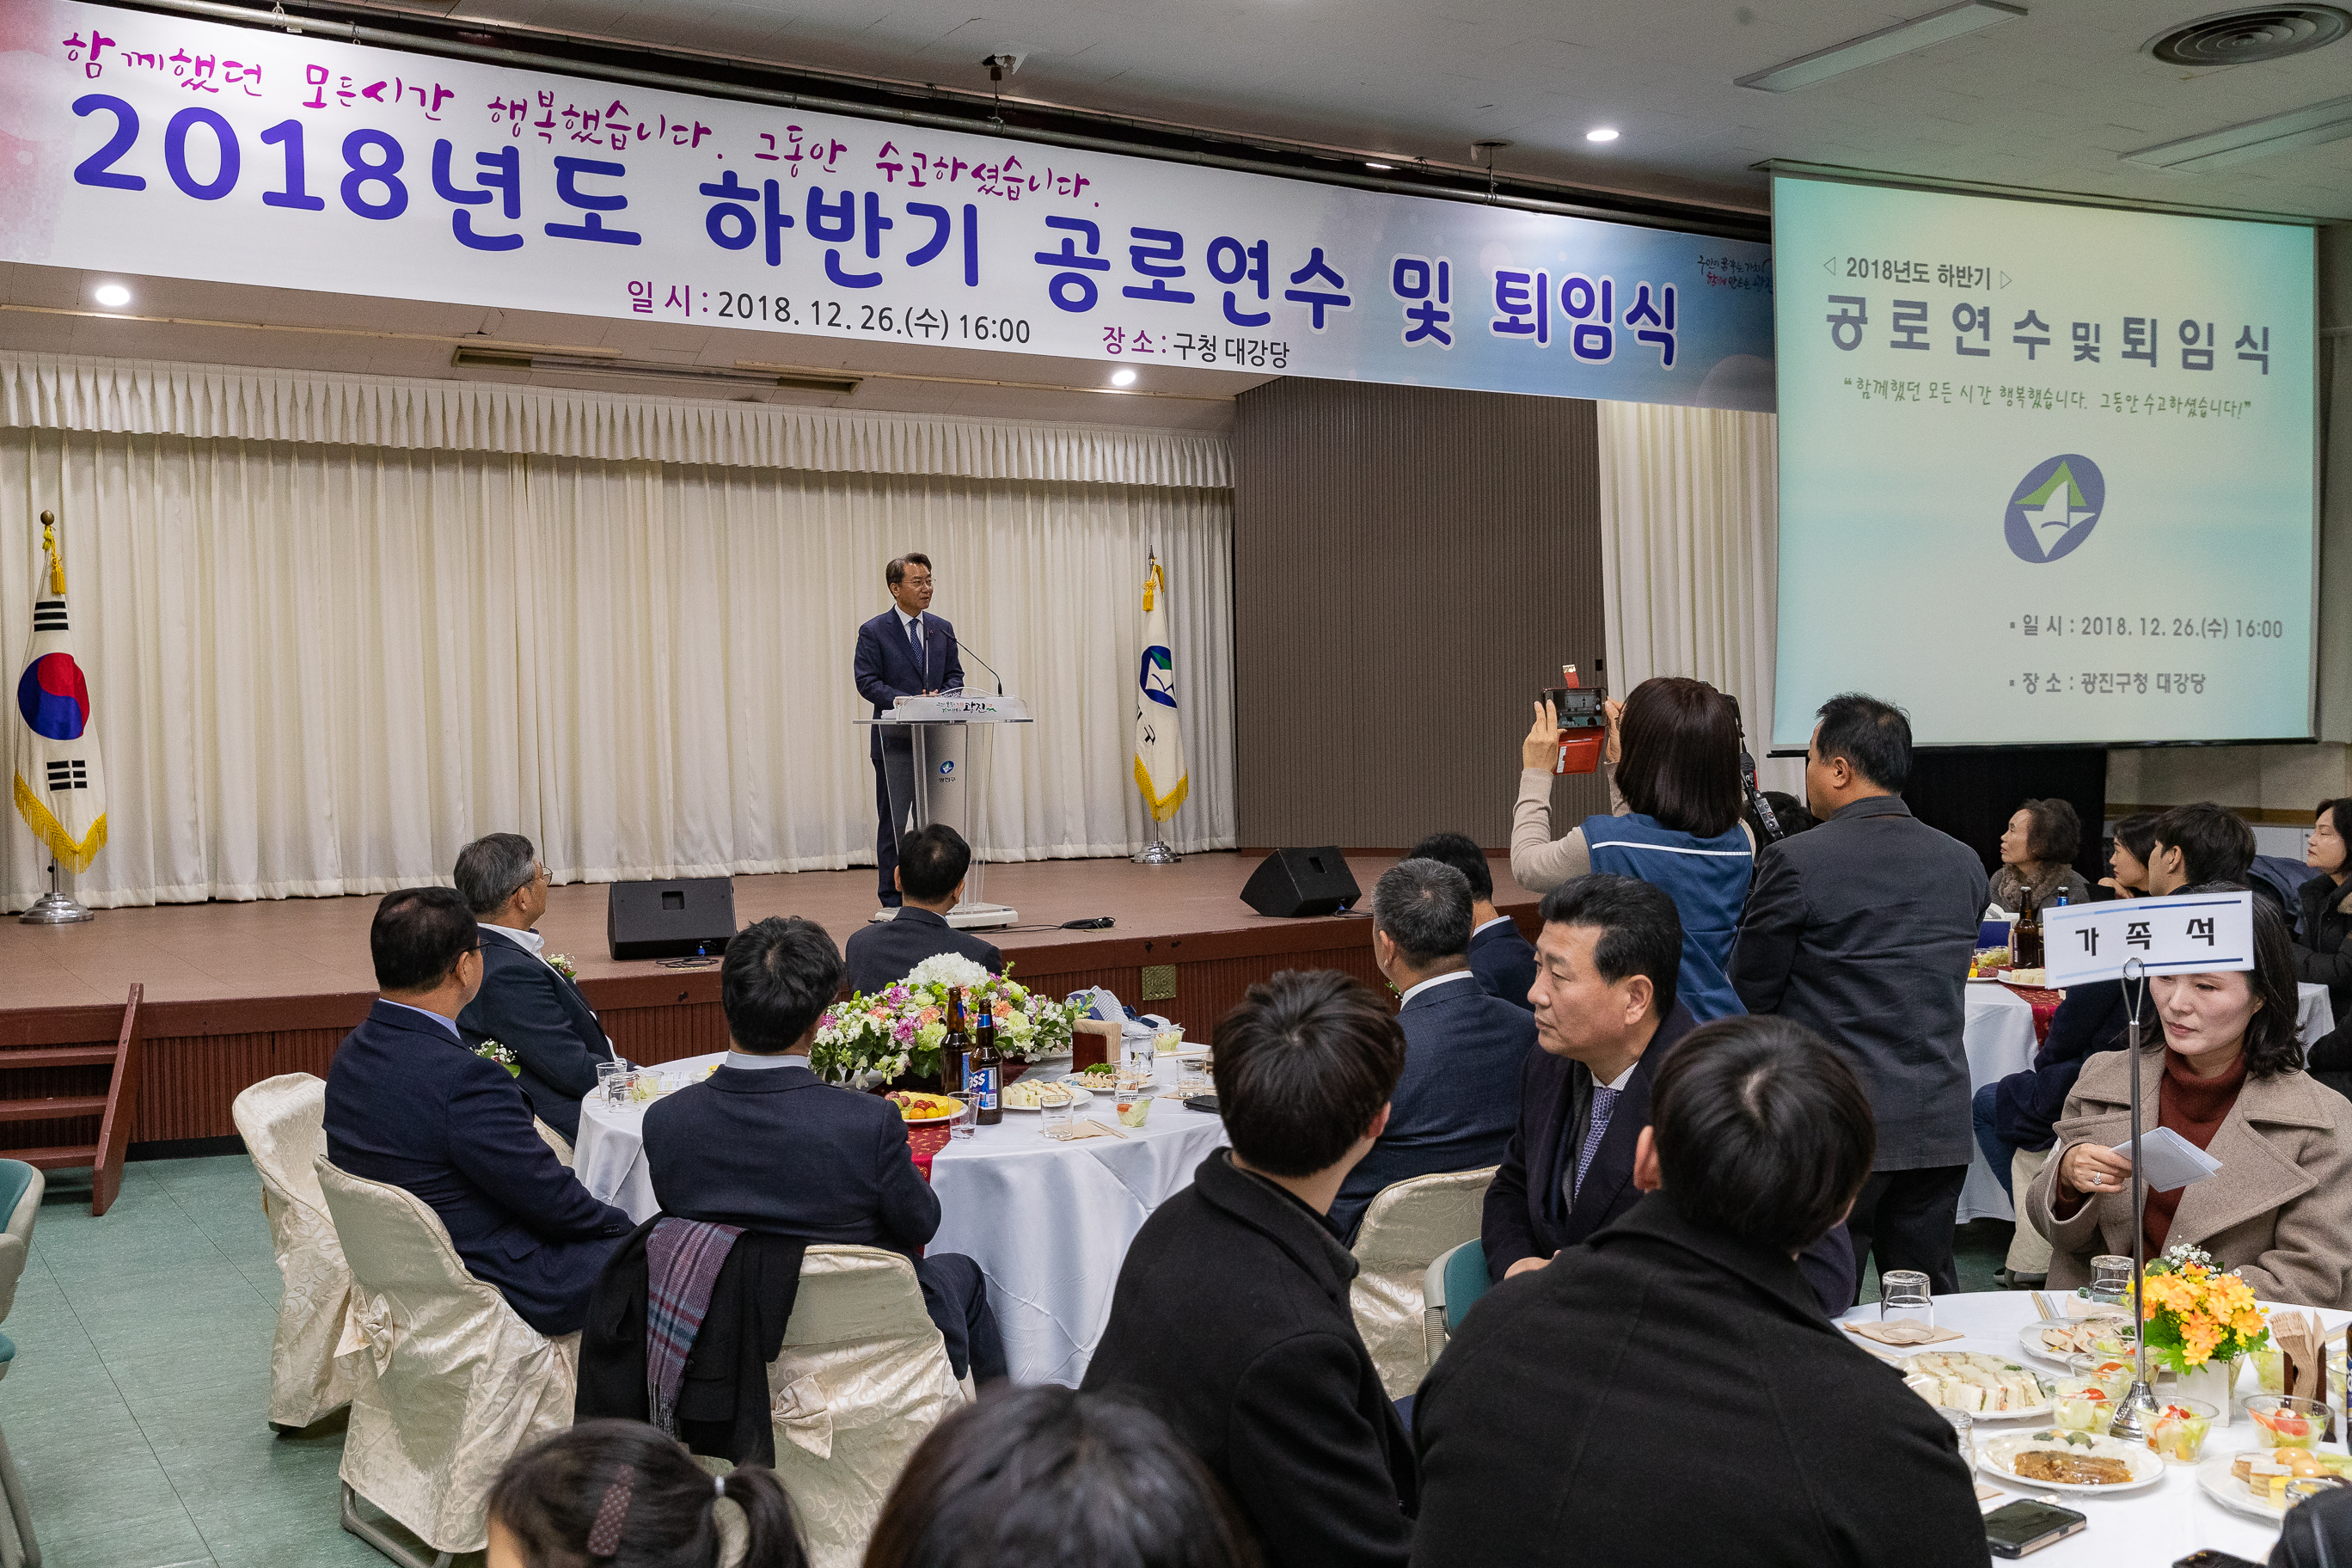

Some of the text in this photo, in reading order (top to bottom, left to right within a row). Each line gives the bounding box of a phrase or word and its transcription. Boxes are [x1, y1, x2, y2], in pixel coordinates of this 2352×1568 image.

[63, 30, 262, 97] 함께했던
[487, 89, 724, 160] 행복했습니다.
[754, 126, 848, 178] 그동안
[875, 140, 1100, 208] 수고하셨습니다.
[71, 94, 1675, 367] 2018년도 하반기 공로연수 및 퇴임식
[1847, 257, 1991, 291] 2018년도 하반기
[718, 291, 799, 326] 2018.
[811, 301, 852, 328] 12.
[861, 304, 949, 341] 26.(수)
[959, 315, 1031, 344] 16:00
[1173, 332, 1217, 362] 구청
[1225, 338, 1290, 369] 대강당
[1929, 381, 1952, 404] 모든
[2000, 385, 2087, 411] 행복했습니다.
[2100, 390, 2139, 414] 그동안
[2081, 616, 2133, 636] 2018.
[2141, 617, 2166, 636] 12.
[2173, 617, 2229, 639] 26.(수)
[2236, 619, 2283, 639] 16:00
[2081, 672, 2149, 695] 광진구청
[2156, 672, 2207, 695] 대강당
